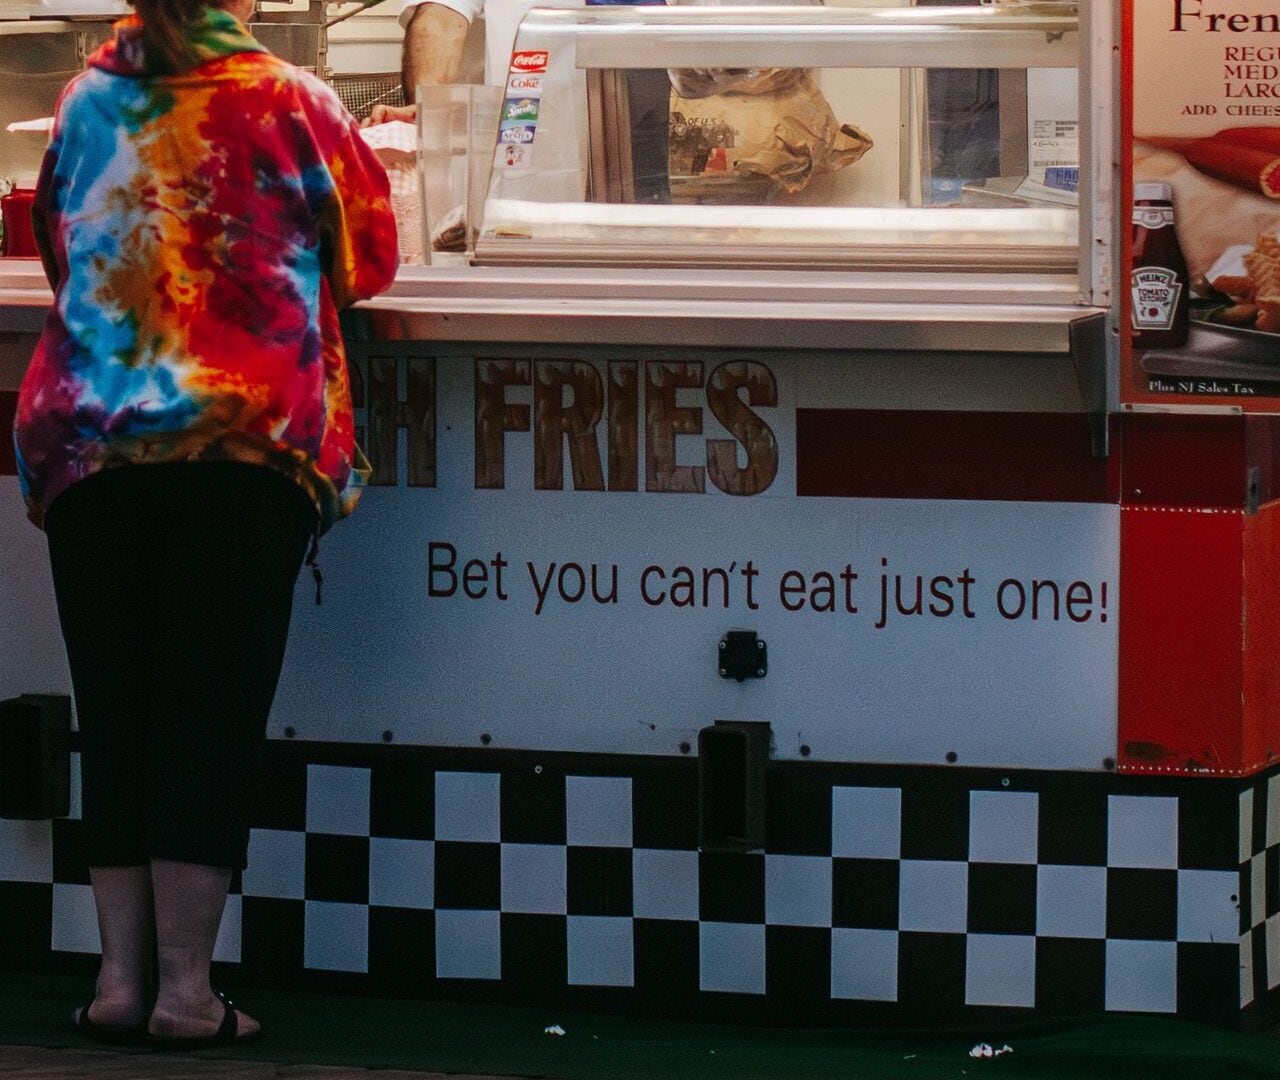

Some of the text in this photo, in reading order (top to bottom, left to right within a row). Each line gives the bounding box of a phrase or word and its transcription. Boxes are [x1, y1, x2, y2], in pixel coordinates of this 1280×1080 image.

[510, 78, 540, 89] Coke
[1181, 104, 1217, 117] ADD
[1139, 273, 1168, 284] HEINZ
[1138, 288, 1169, 296] TOMATO
[1148, 381, 1255, 395] Plus NJ Sales Tax
[474, 358, 778, 497] FRIES
[426, 541, 1111, 629] Bet you can't eat just one!
